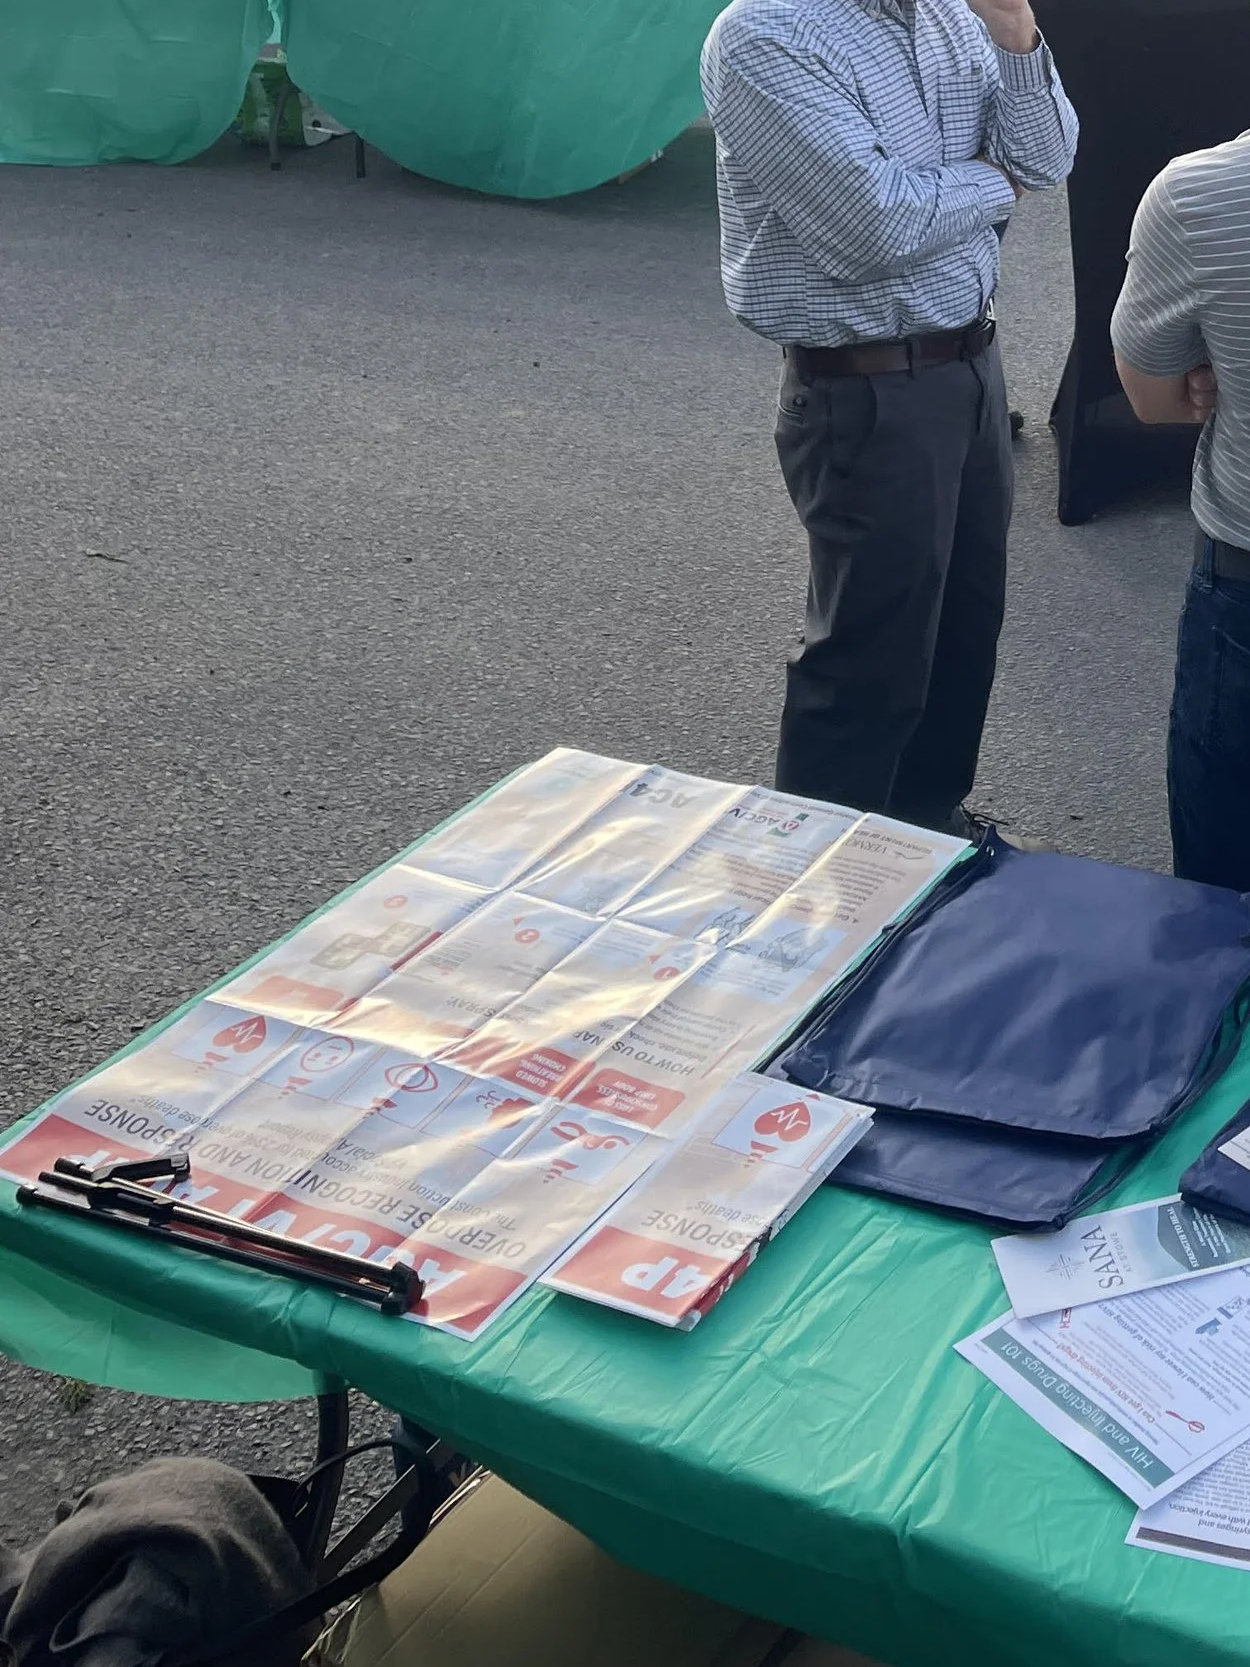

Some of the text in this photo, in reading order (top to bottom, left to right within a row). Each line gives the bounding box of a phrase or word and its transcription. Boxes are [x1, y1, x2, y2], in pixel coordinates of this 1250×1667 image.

[82, 1099, 527, 1259] OVERDOSE RECOGNITION AND RESPONSE
[1080, 1224, 1124, 1290] SANA
[1000, 1341, 1154, 1469] HIV and Injecting Drugs 101
